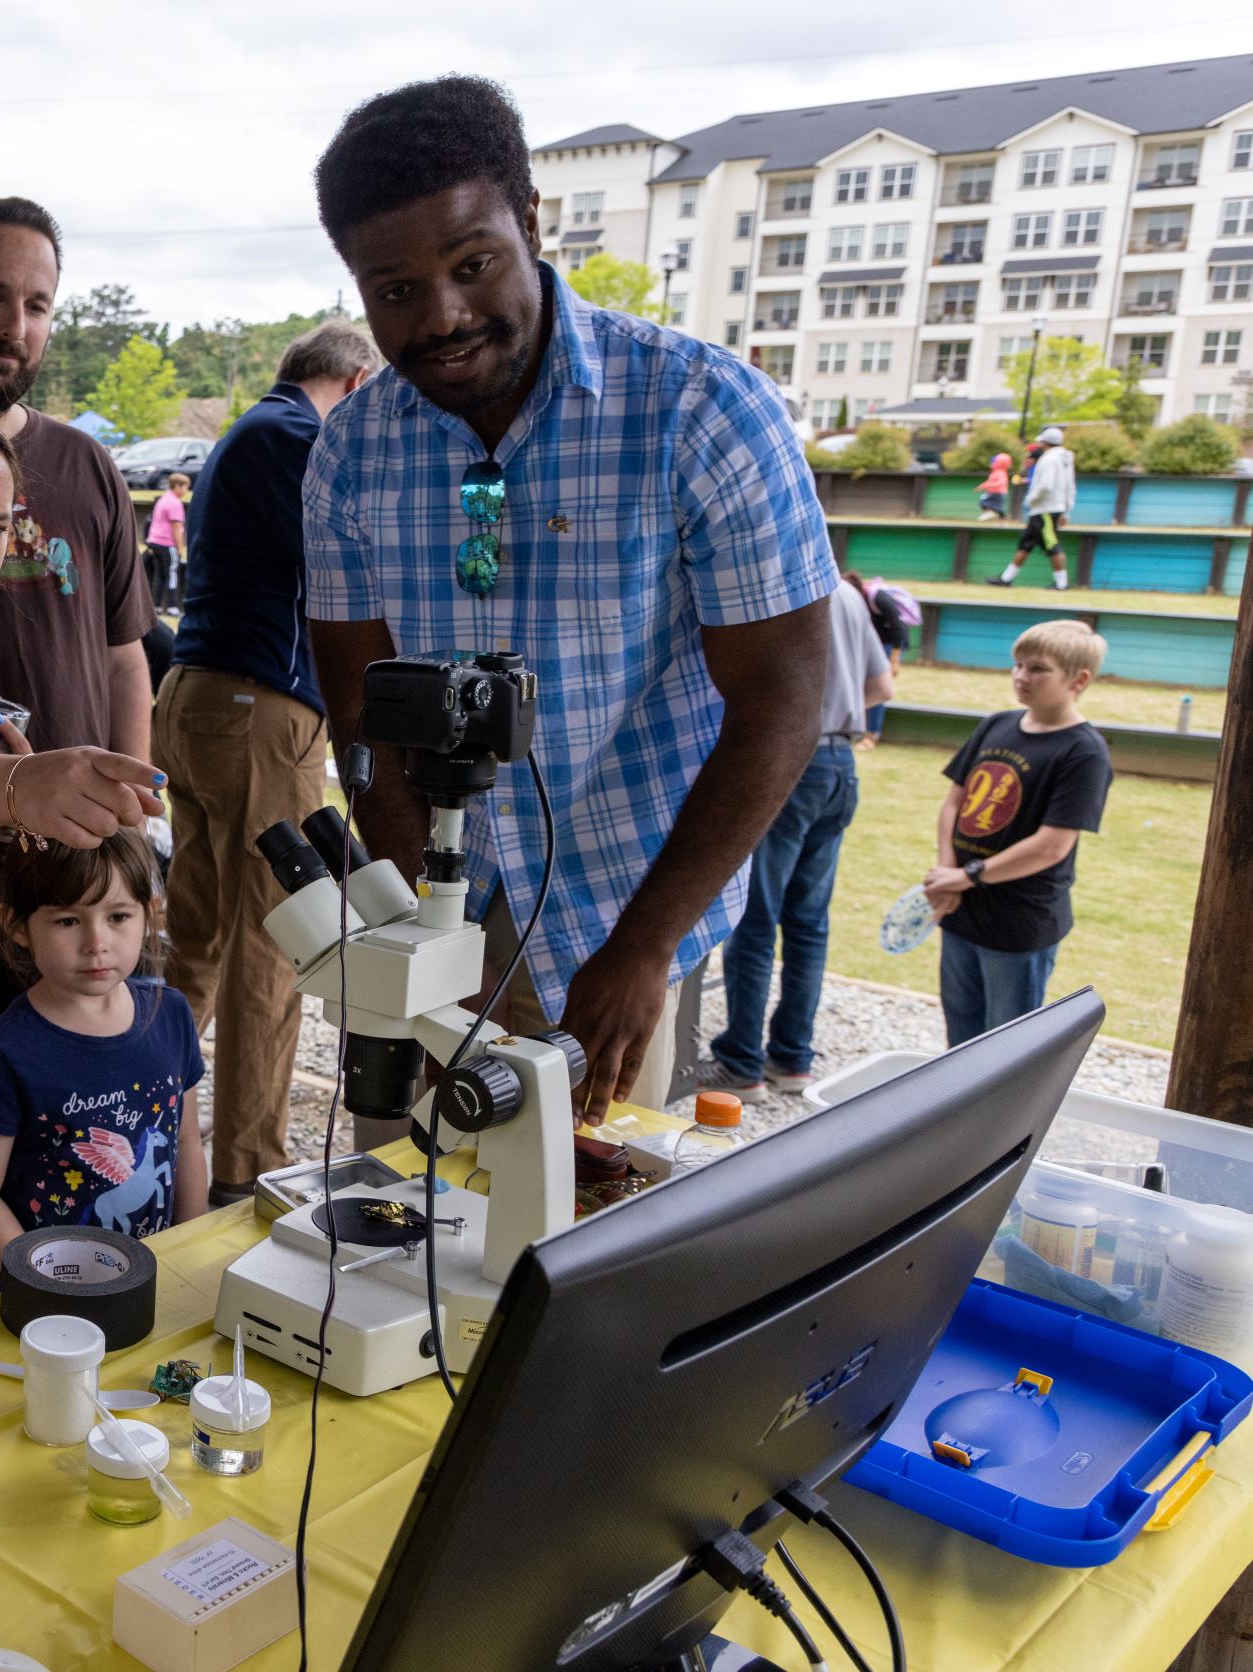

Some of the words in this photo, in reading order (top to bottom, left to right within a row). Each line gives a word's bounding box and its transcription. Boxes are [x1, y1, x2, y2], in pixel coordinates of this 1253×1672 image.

[62, 1090, 127, 1116] dream
[452, 1087, 472, 1117] TENSION
[110, 1104, 143, 1130] big
[54, 1266, 79, 1275] ULINE
[239, 1561, 259, 1574] Rocks
[207, 1575, 235, 1592] Minerals
